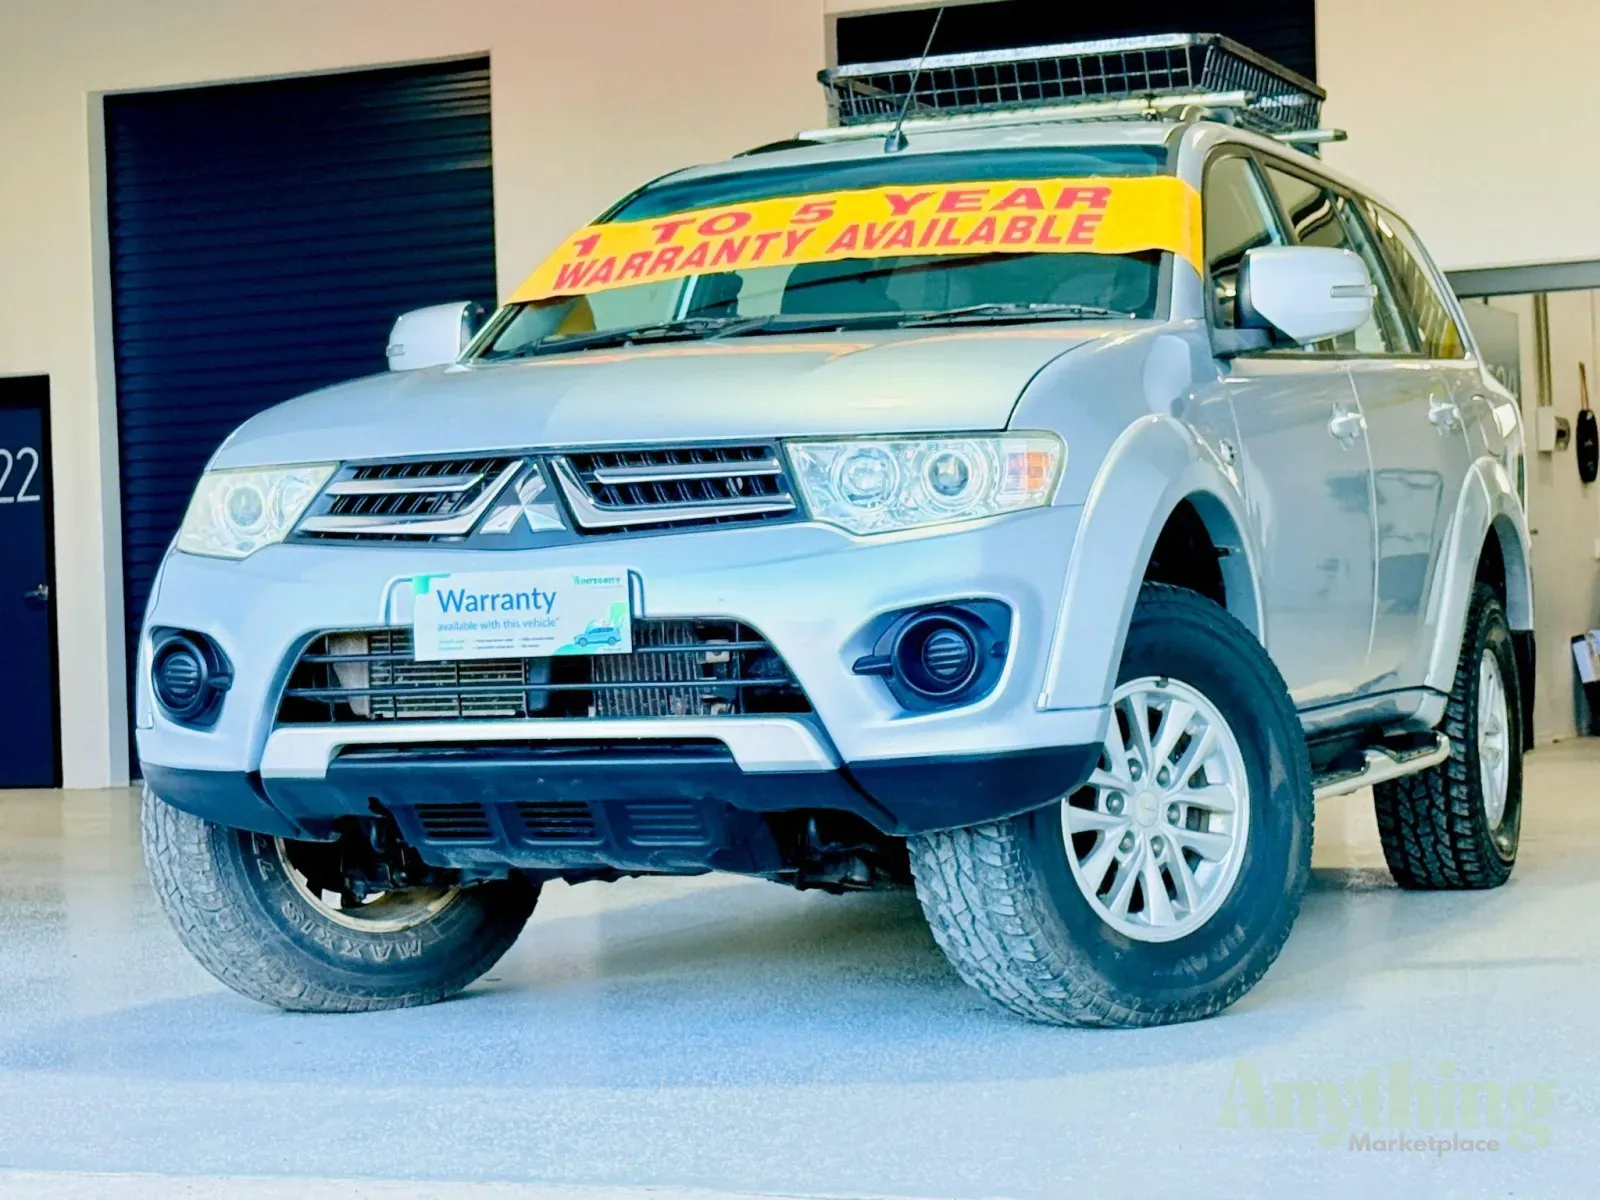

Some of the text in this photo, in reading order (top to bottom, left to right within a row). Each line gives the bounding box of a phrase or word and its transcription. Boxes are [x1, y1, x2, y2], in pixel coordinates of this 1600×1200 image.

[553, 213, 1104, 291] WARRANTY AVAILABLE
[573, 187, 1113, 257] 1 TO 5 YEAR
[436, 587, 557, 615] Warranty
[437, 620, 478, 632] available
[480, 618, 500, 630] with
[503, 618, 521, 629] this
[281, 900, 422, 962] MAXXIS
